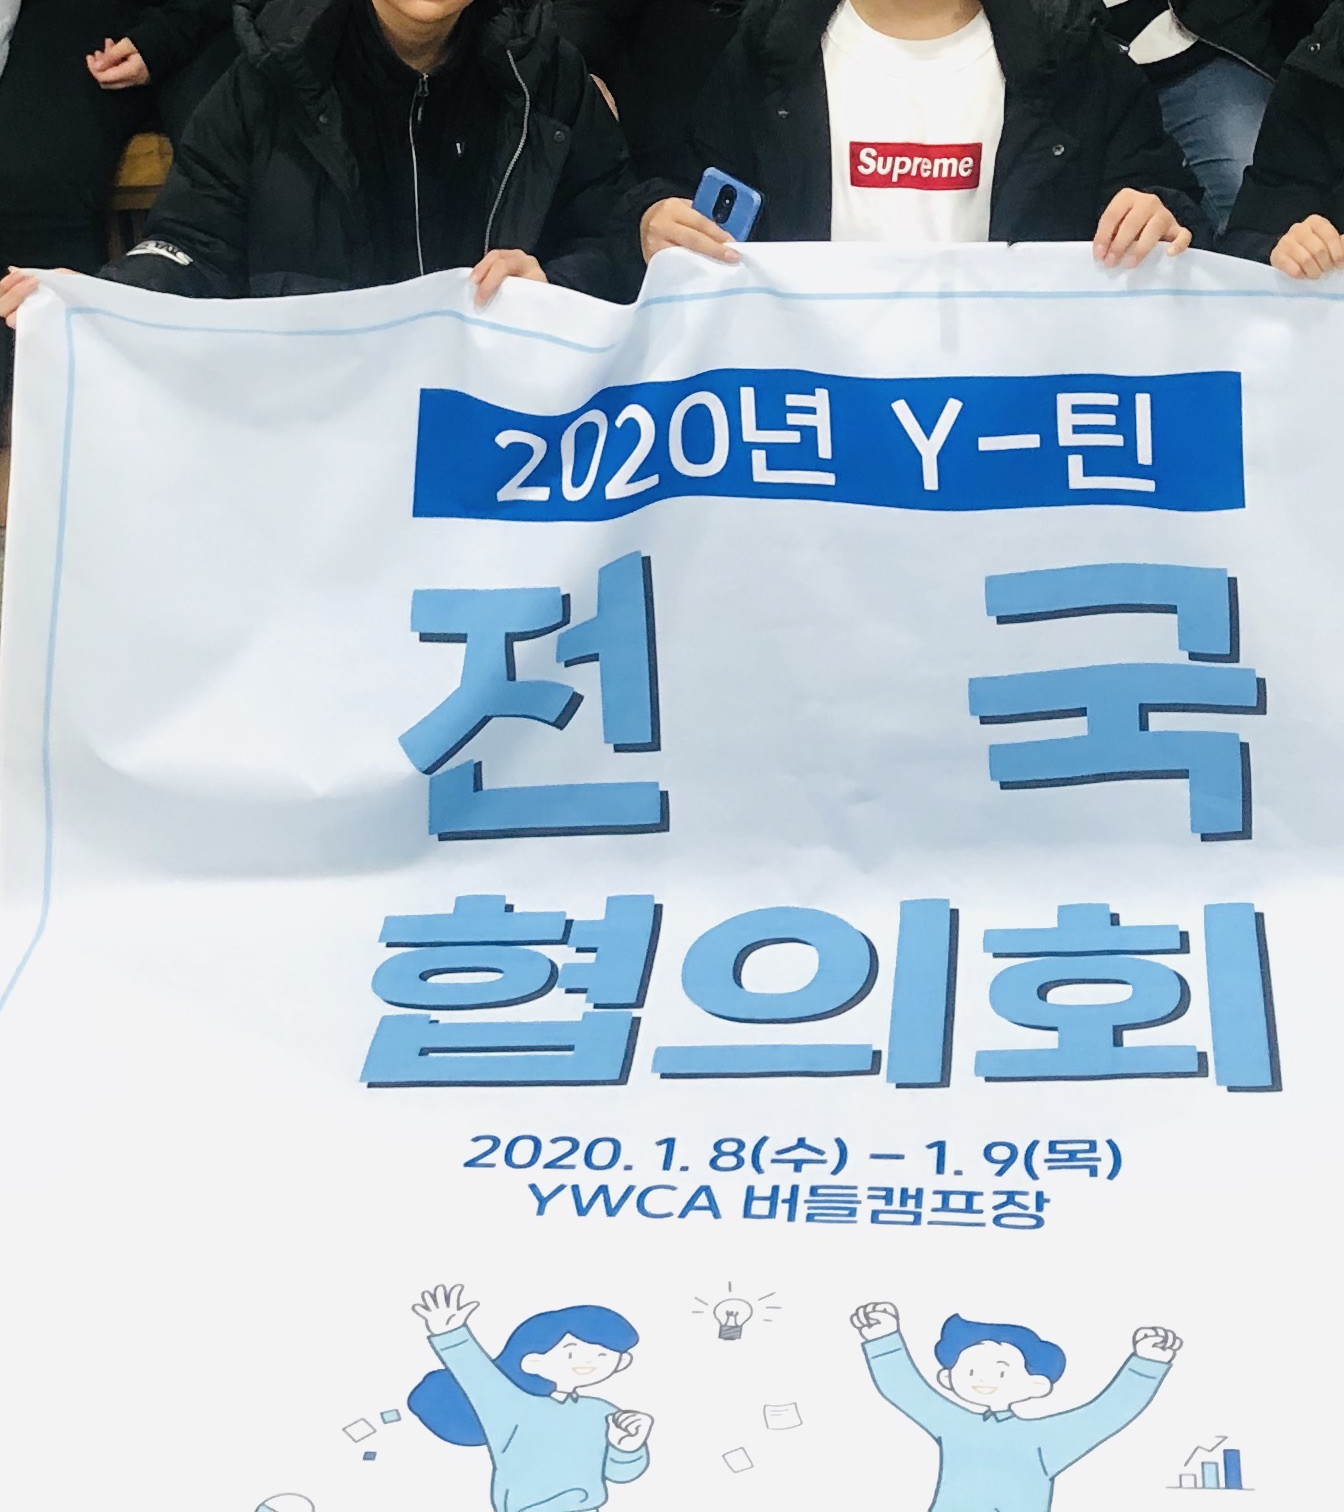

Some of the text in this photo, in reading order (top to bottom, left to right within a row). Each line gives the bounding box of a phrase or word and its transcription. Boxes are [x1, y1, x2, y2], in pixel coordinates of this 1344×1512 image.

[857, 147, 974, 183] Supreme
[494, 387, 837, 504] 2020년
[398, 550, 1267, 842] 전 국
[360, 894, 1283, 1093] 협의회
[463, 1134, 633, 1171] 2020.
[528, 1182, 1051, 1230] YWCA 버들캠프장
